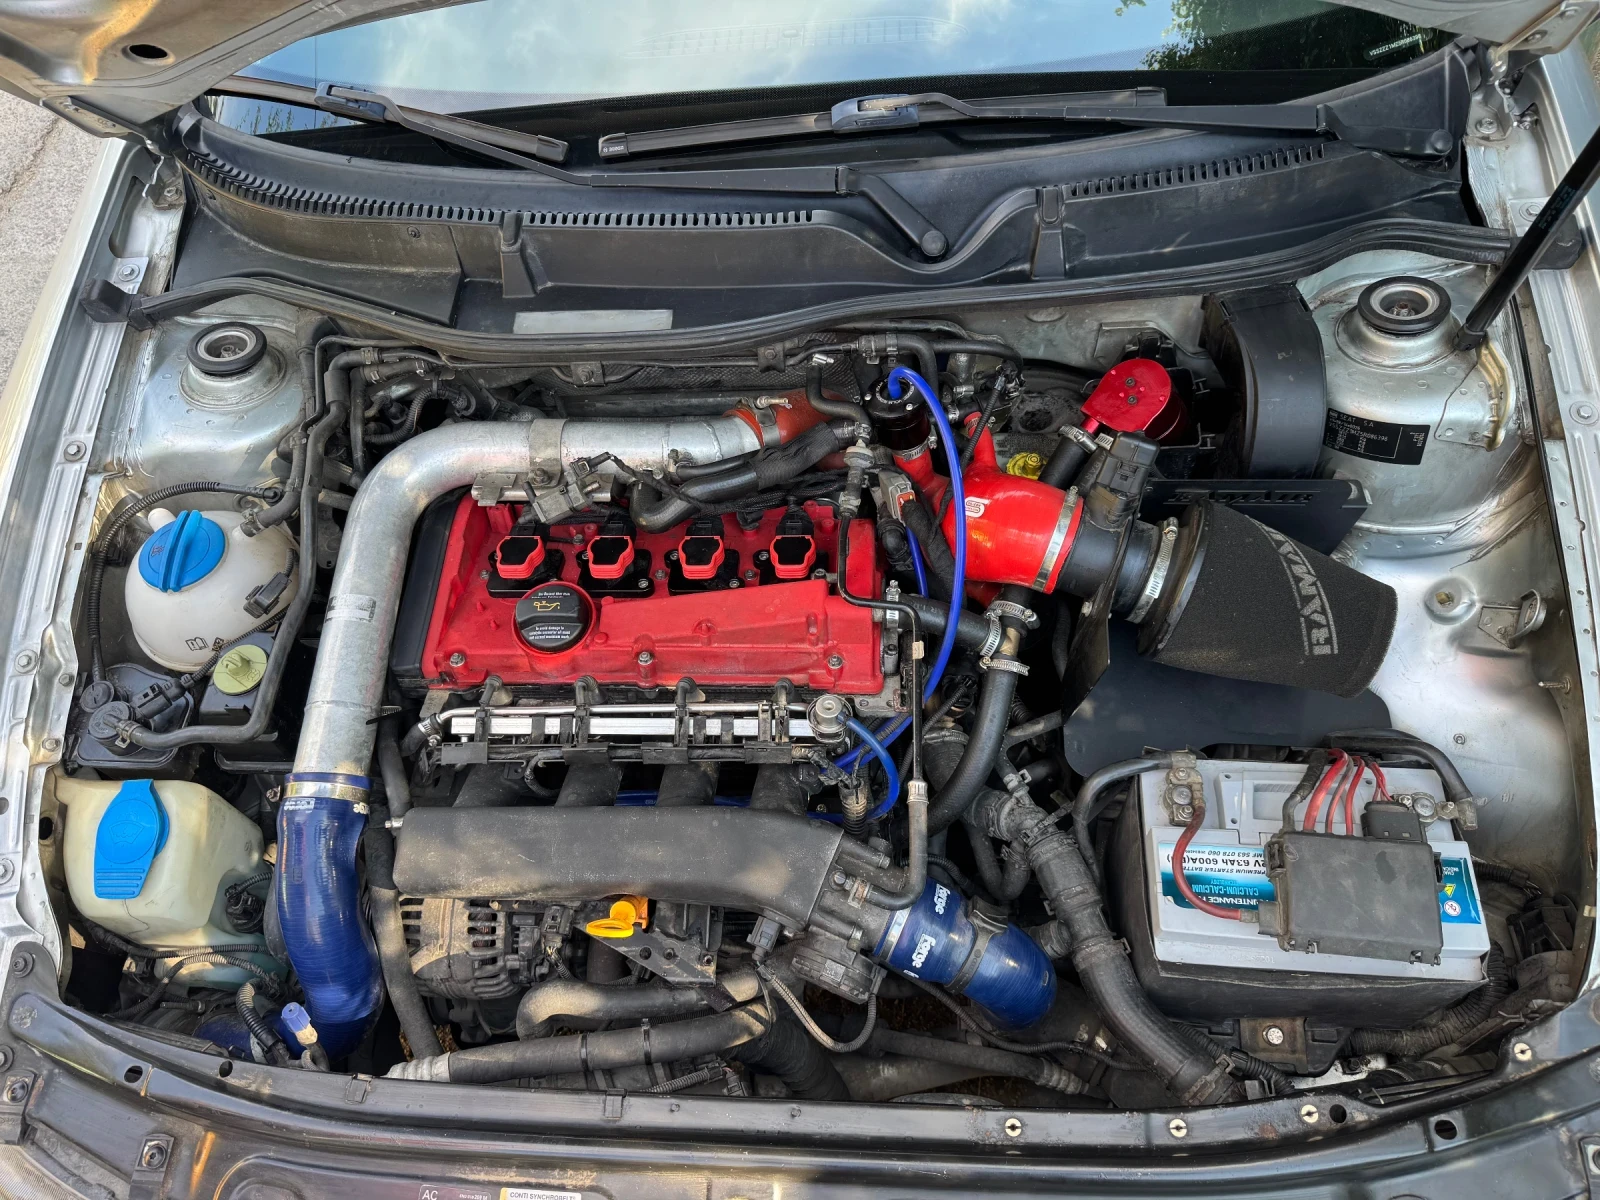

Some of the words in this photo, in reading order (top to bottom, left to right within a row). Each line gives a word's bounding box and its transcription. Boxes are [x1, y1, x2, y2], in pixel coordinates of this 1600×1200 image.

[1340, 414, 1356, 423] SEAT
[1260, 524, 1333, 656] RAMAI
[1221, 858, 1250, 867] 63Ah
[1253, 859, 1266, 868] 2V
[1191, 883, 1259, 896] CALCIUM-CALCIUM
[421, 1189, 438, 1200] AC
[510, 1191, 529, 1199] CONTI
